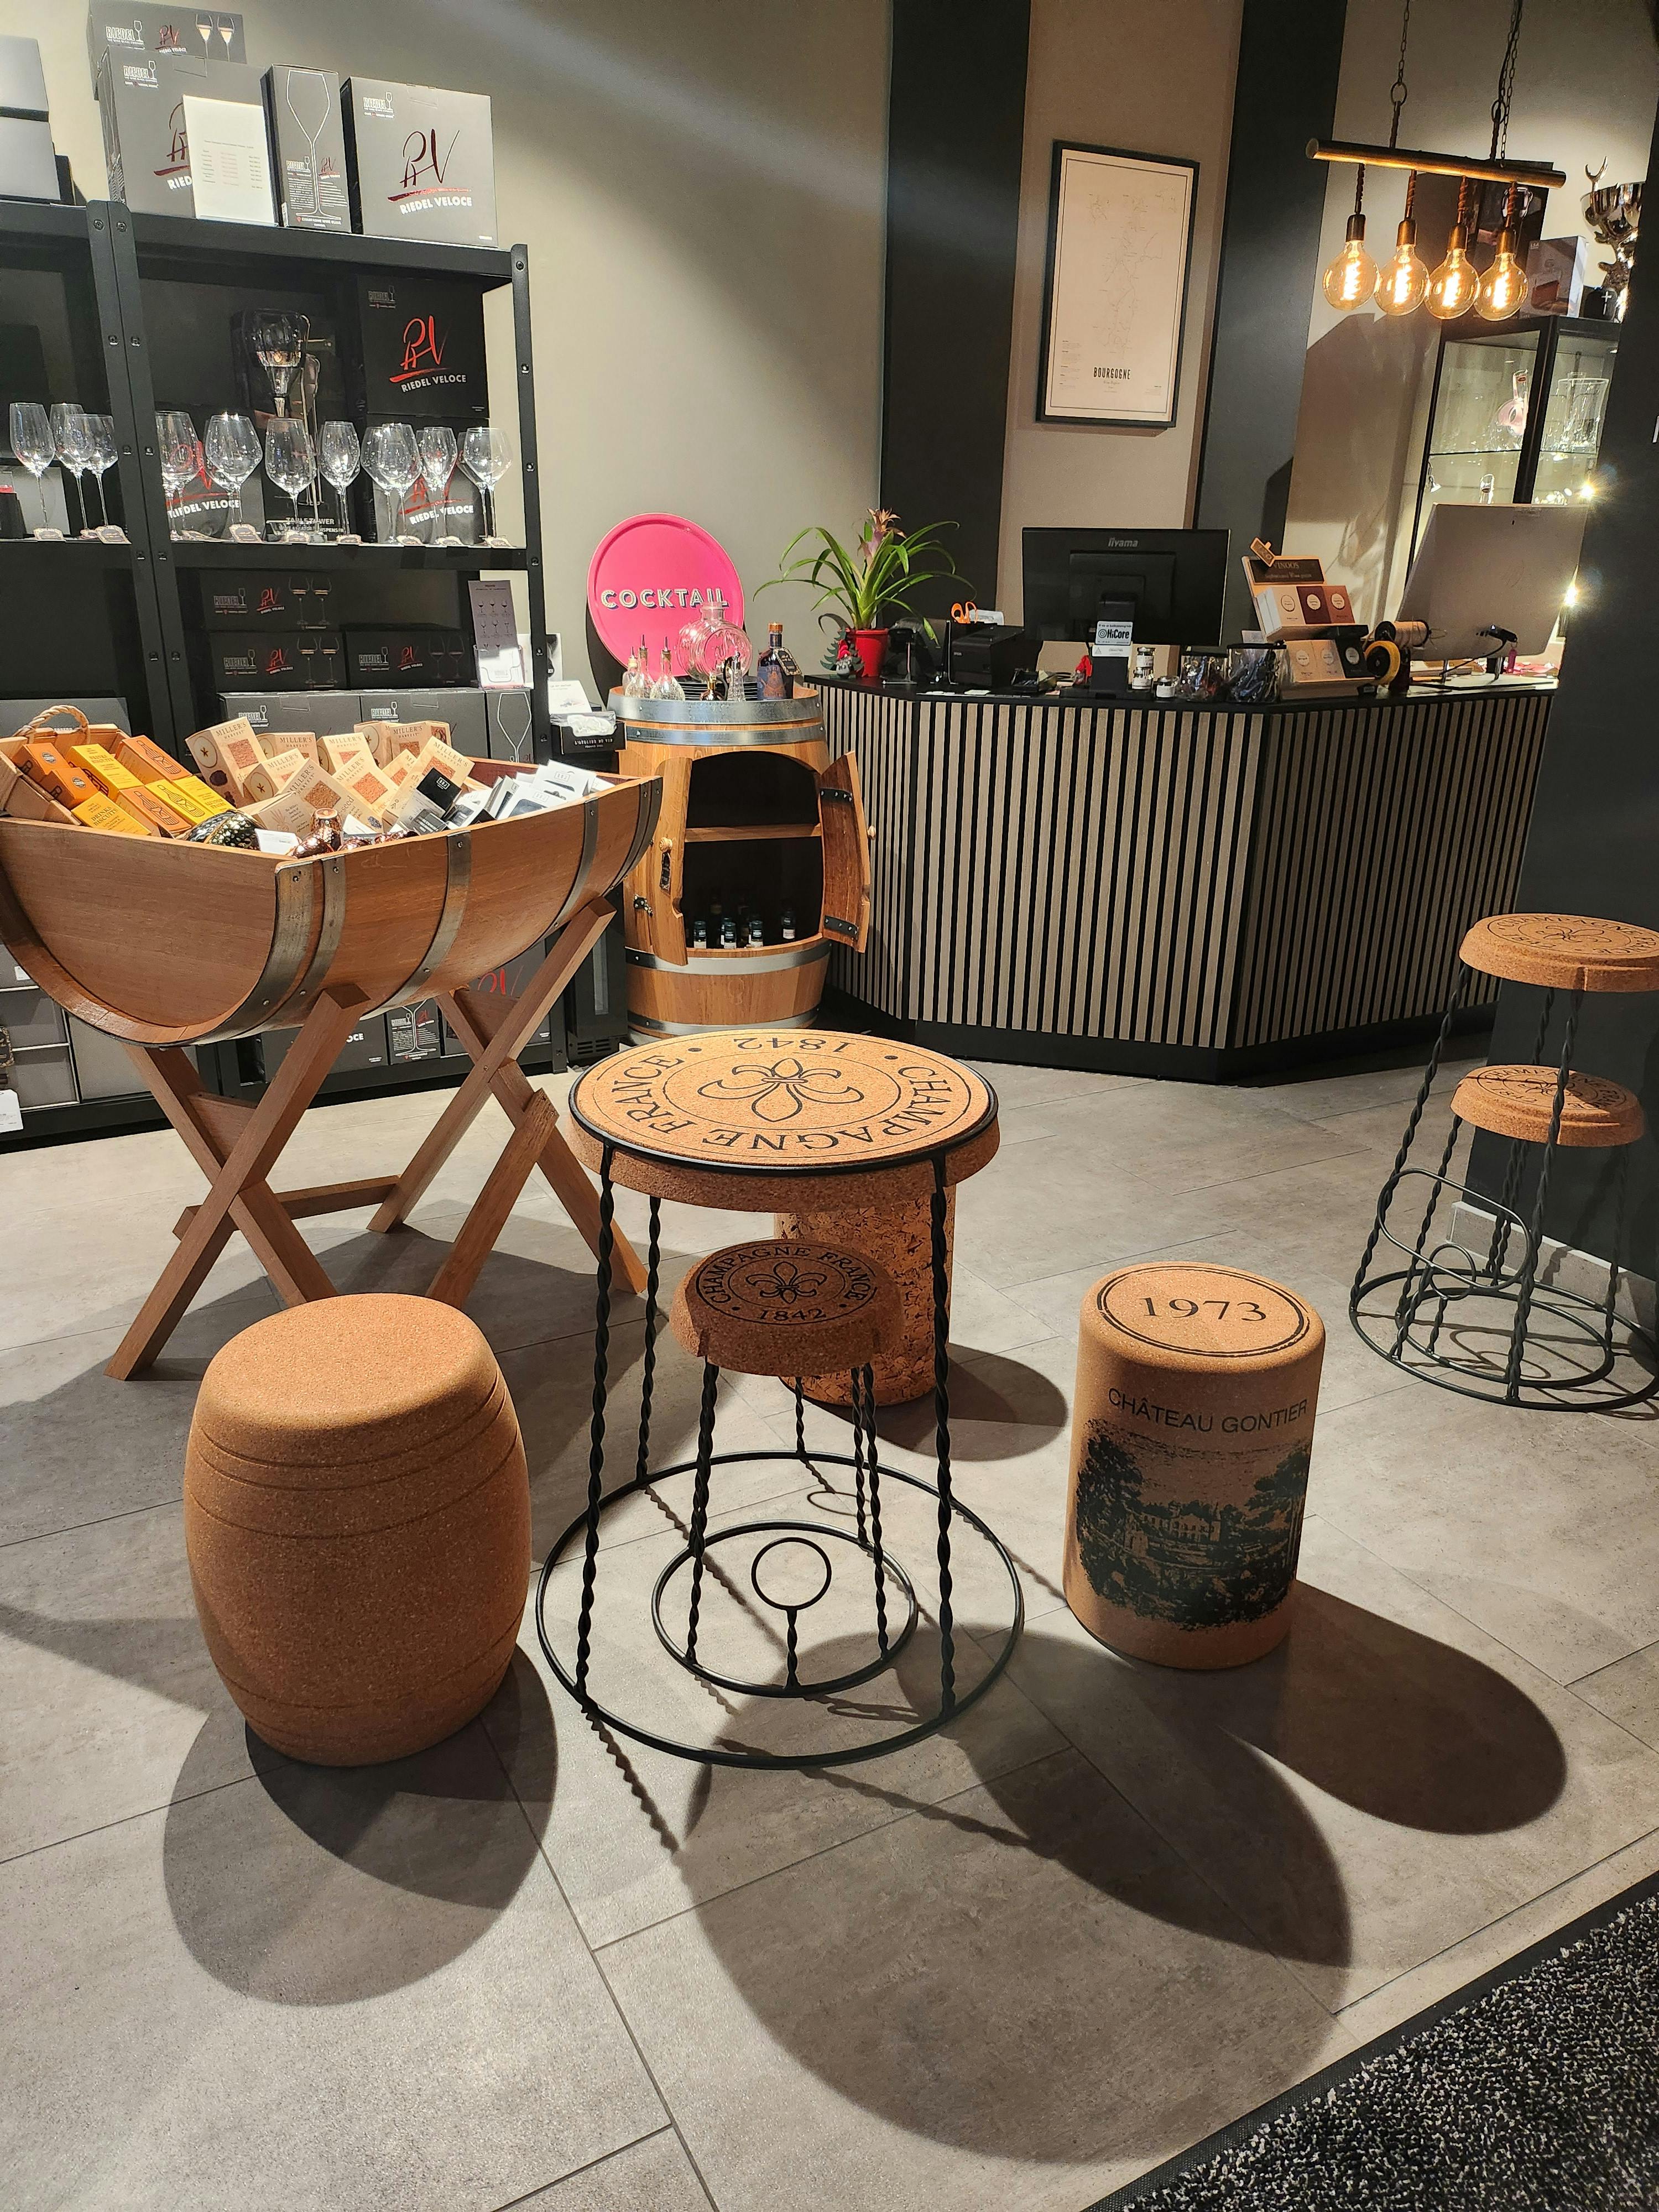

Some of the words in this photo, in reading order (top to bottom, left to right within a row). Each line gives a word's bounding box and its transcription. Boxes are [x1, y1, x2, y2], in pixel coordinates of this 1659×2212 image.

[167, 176, 192, 190] RIED
[399, 198, 434, 215] RIEDEL
[435, 196, 472, 207] VELOCE
[1093, 367, 1131, 380] BOURGOGNE
[401, 378, 431, 393] RIEDEL
[432, 374, 467, 385] VELOCE
[202, 499, 241, 510] VELOCE
[409, 512, 439, 525] RIEDEL
[601, 588, 728, 609] COCKTAIL
[1107, 629, 1130, 639] HiCore
[216, 723, 247, 737] MILLER'S
[393, 726, 422, 734] MILLER'S
[329, 735, 362, 744] MILLER'S
[267, 753, 299, 769] MILLER'S
[433, 742, 468, 768] MILLER'S
[337, 757, 365, 782] MILLER'S
[91, 806, 112, 822] DRINKS
[93, 808, 118, 826] BISCUITS
[733, 1036, 855, 1053] 1842
[611, 1053, 698, 1138] FRANCE
[702, 1066, 953, 1151] CHAMPAGNE
[703, 1245, 811, 1304] CHAMPAGNE
[816, 1251, 872, 1301] FRANCE
[757, 1307, 827, 1322] 1842
[1140, 1297, 1266, 1322] 1973
[1108, 1387, 1213, 1432] CHÂTEAU
[1222, 1398, 1308, 1433] GONTIER
